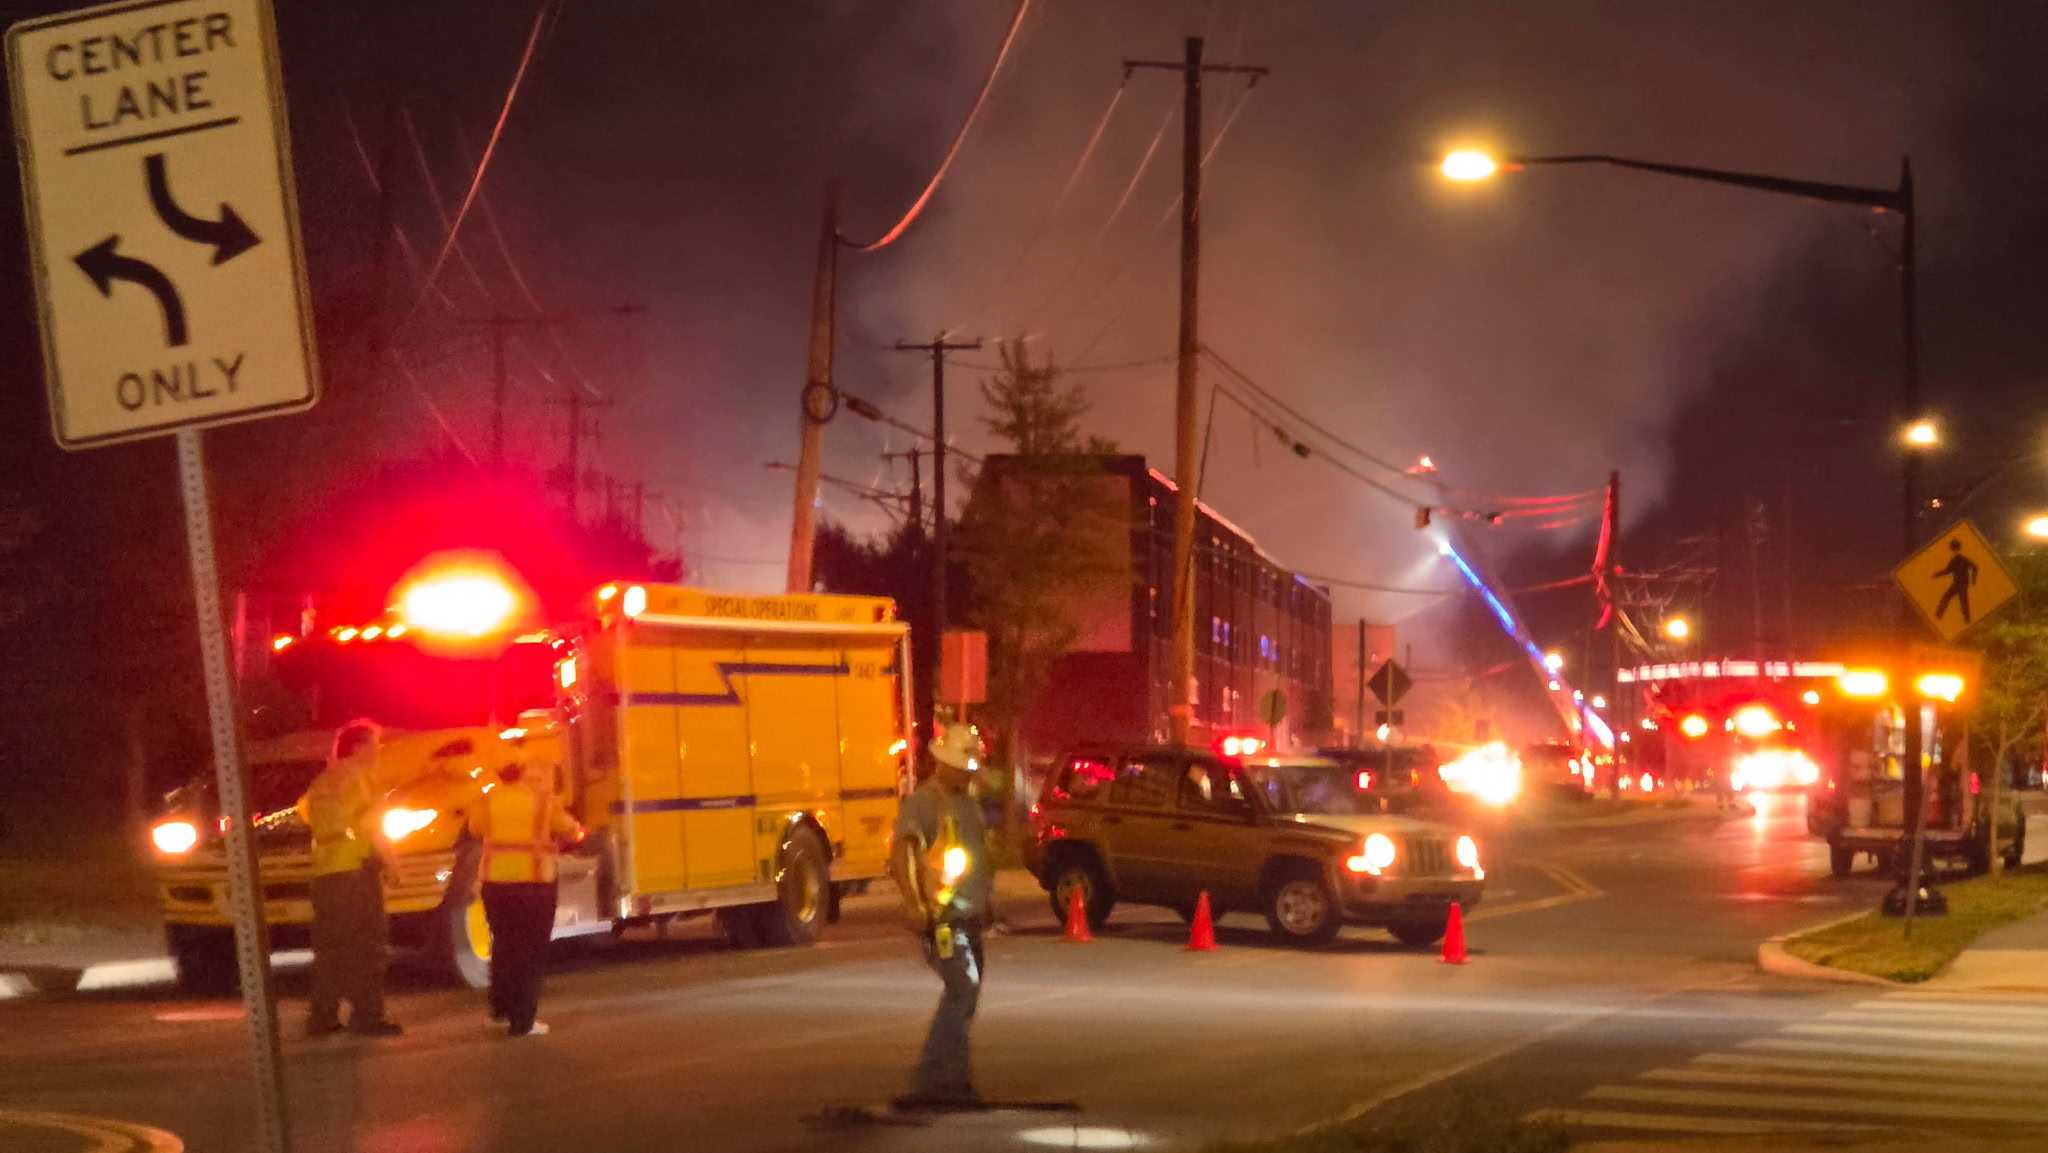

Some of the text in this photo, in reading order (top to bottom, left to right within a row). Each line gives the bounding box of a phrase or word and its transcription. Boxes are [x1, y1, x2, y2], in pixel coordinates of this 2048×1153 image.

[46, 12, 237, 81] CENTER
[80, 71, 213, 131] LANE
[116, 353, 246, 412] ONLY
[704, 597, 746, 617] SPECIAL
[750, 598, 817, 620] OPERATIONS
